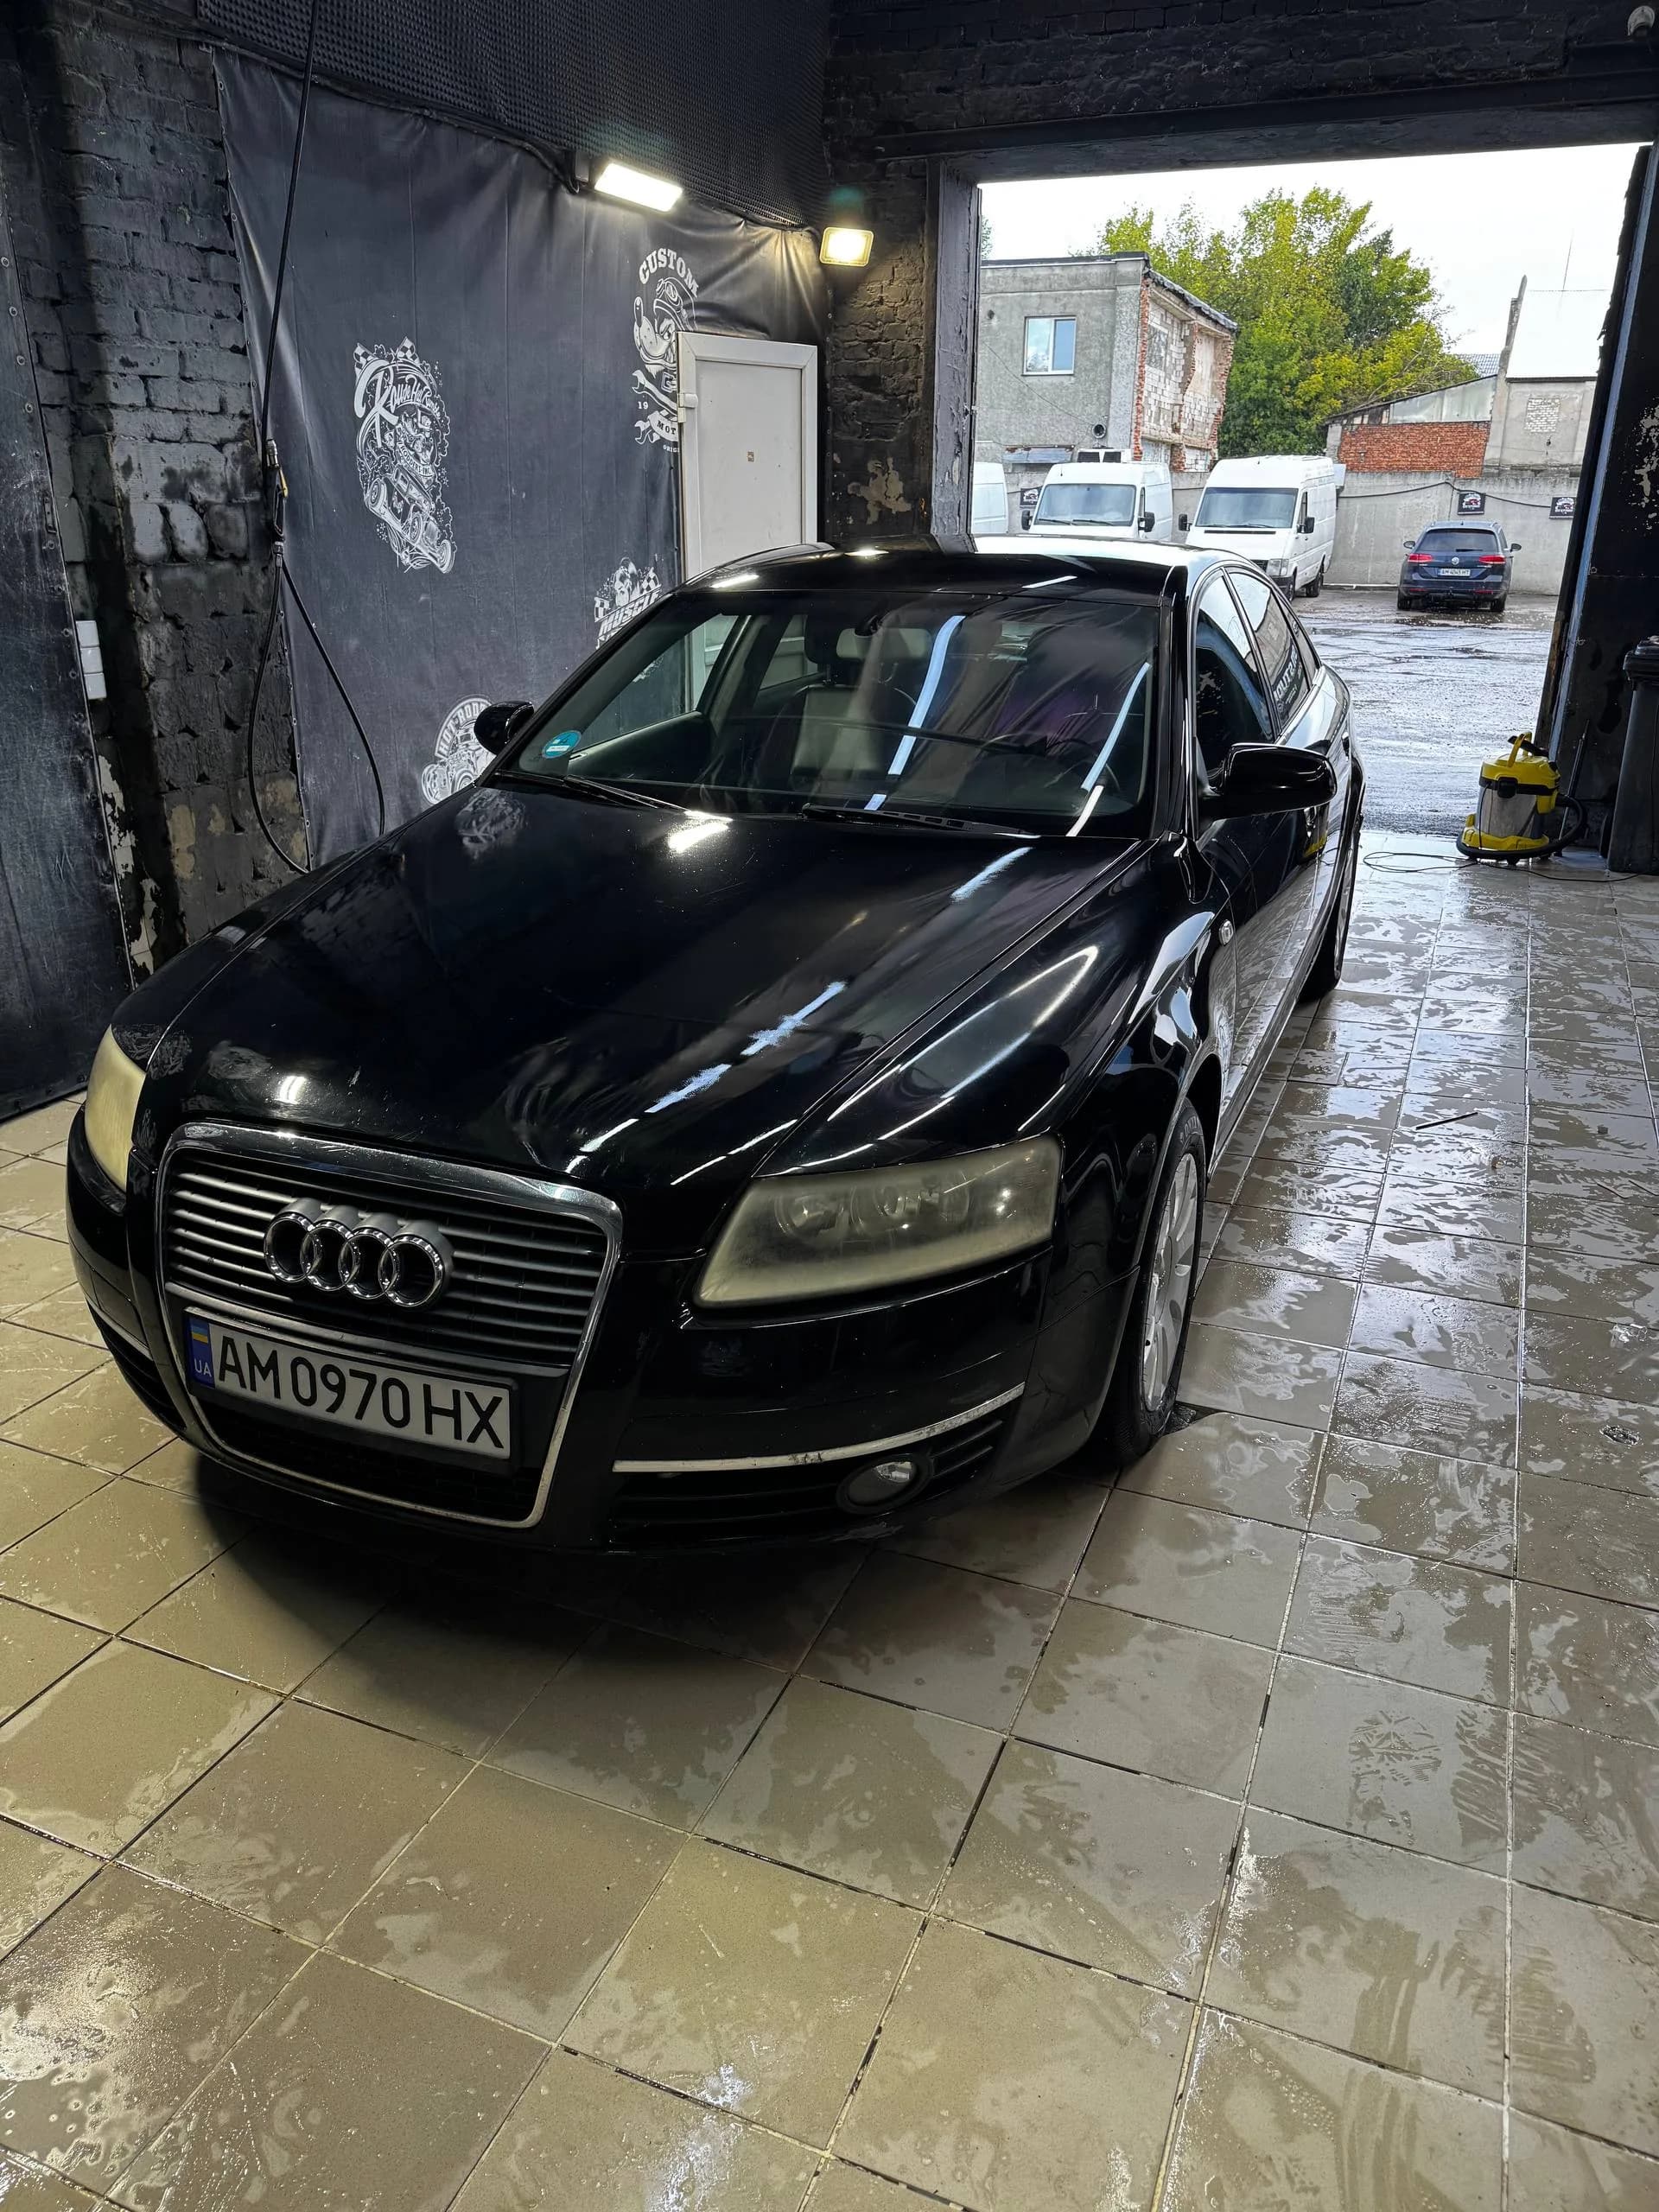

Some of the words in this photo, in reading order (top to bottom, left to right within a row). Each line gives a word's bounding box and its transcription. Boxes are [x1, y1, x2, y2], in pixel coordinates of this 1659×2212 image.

[639, 248, 698, 298] CUSTOM
[638, 401, 649, 410] 19
[194, 1358, 212, 1377] UA
